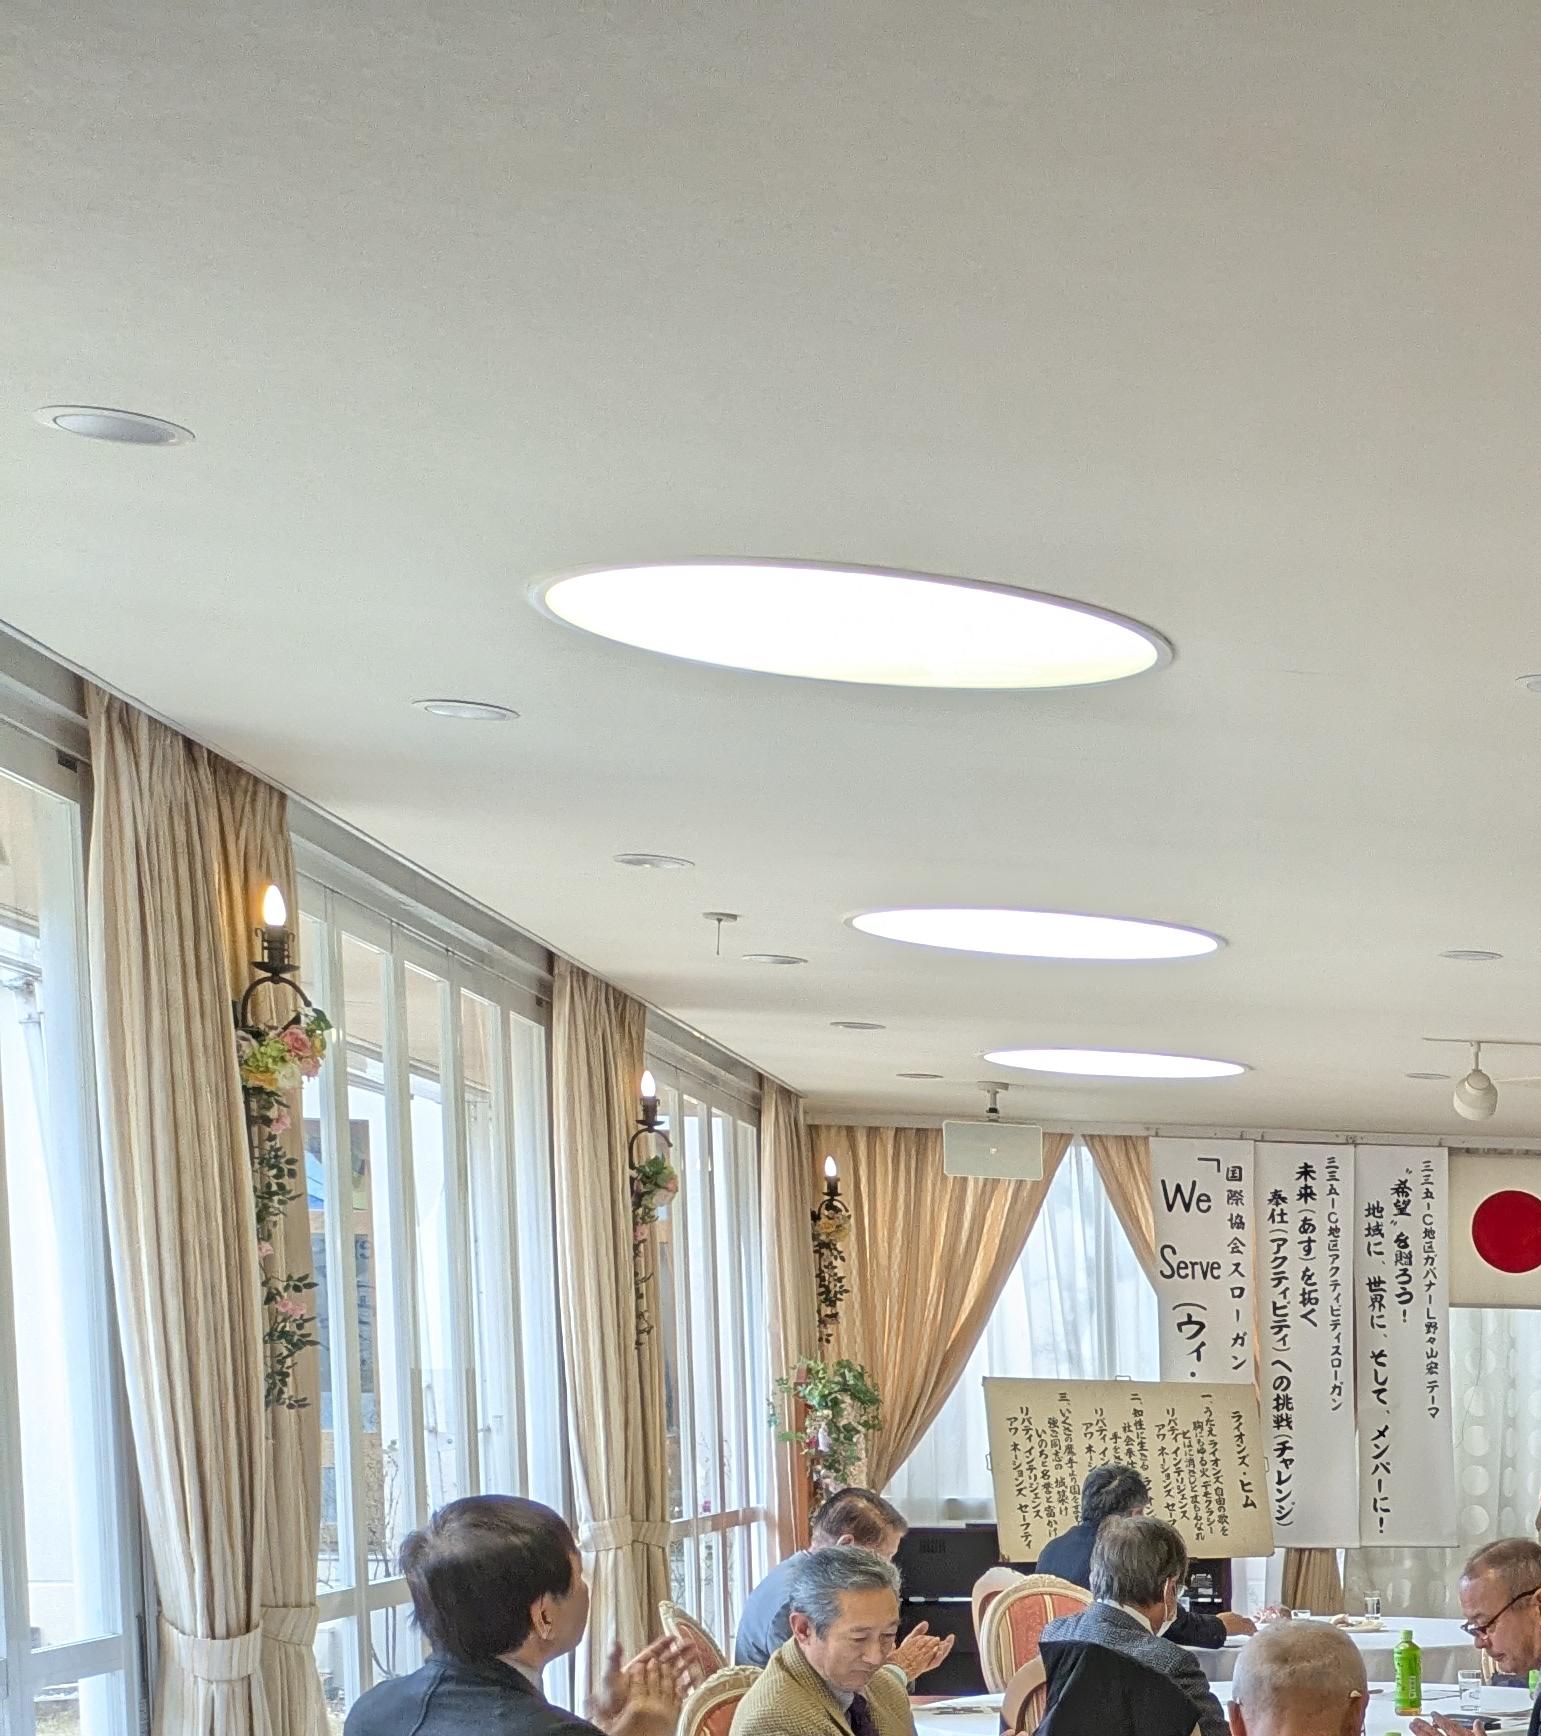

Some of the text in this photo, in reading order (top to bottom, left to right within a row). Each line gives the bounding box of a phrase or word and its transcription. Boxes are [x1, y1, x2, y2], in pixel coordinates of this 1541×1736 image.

[1160, 1244, 1221, 1281] Serve
[1225, 1165, 1247, 1370] 国際協会スローガン
[1231, 1411, 1257, 1509] ライオンズ・ヒム
